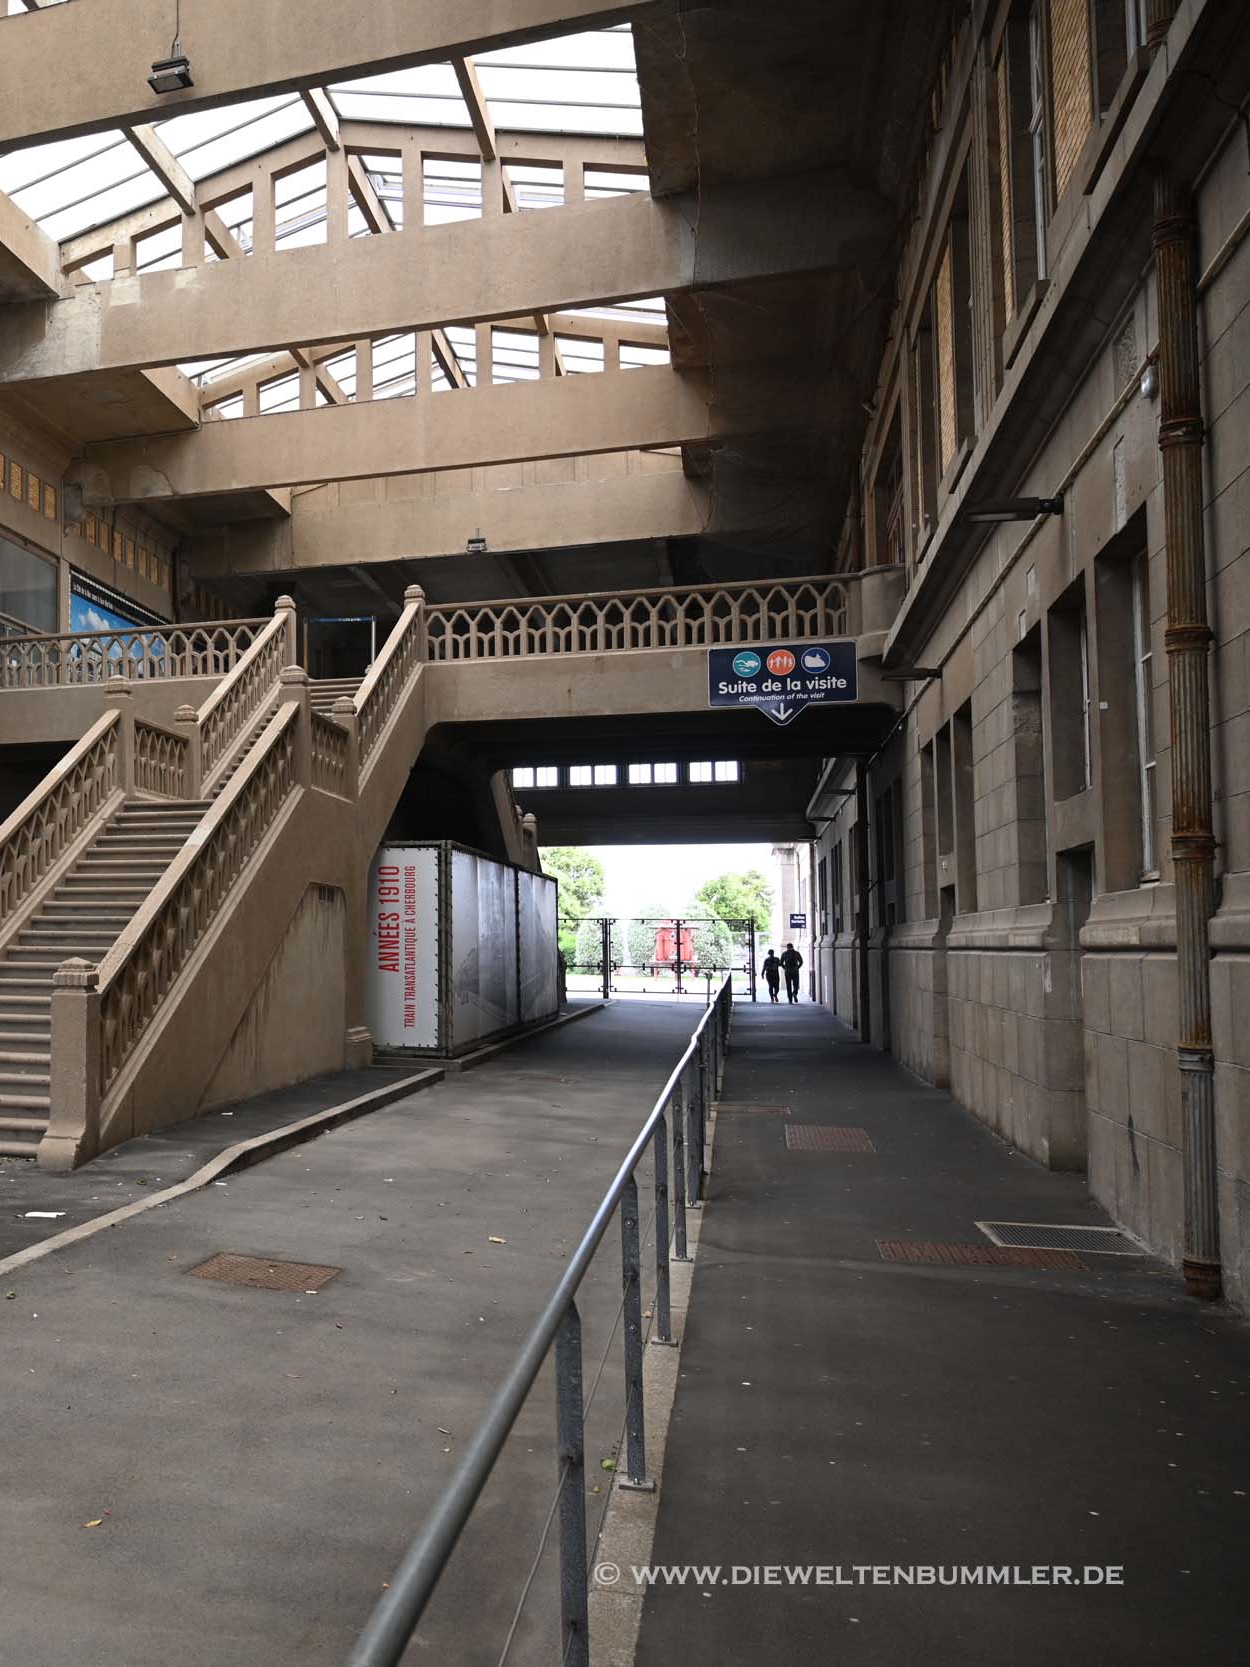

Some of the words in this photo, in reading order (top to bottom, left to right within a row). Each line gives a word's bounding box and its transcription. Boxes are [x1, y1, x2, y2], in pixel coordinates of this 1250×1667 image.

[718, 681, 757, 695] Suite
[762, 678, 782, 692] de
[786, 677, 801, 691] la
[806, 676, 847, 690] visite
[738, 694, 785, 703] Continuation
[796, 692, 808, 700] the
[810, 691, 826, 699] visit
[378, 865, 400, 904] 1910
[404, 865, 416, 916] CHERBOURG
[372, 911, 400, 973] ANNÉES
[404, 926, 418, 1002] TRANSATLANTIQUE
[404, 1003, 416, 1029] TRAIN
